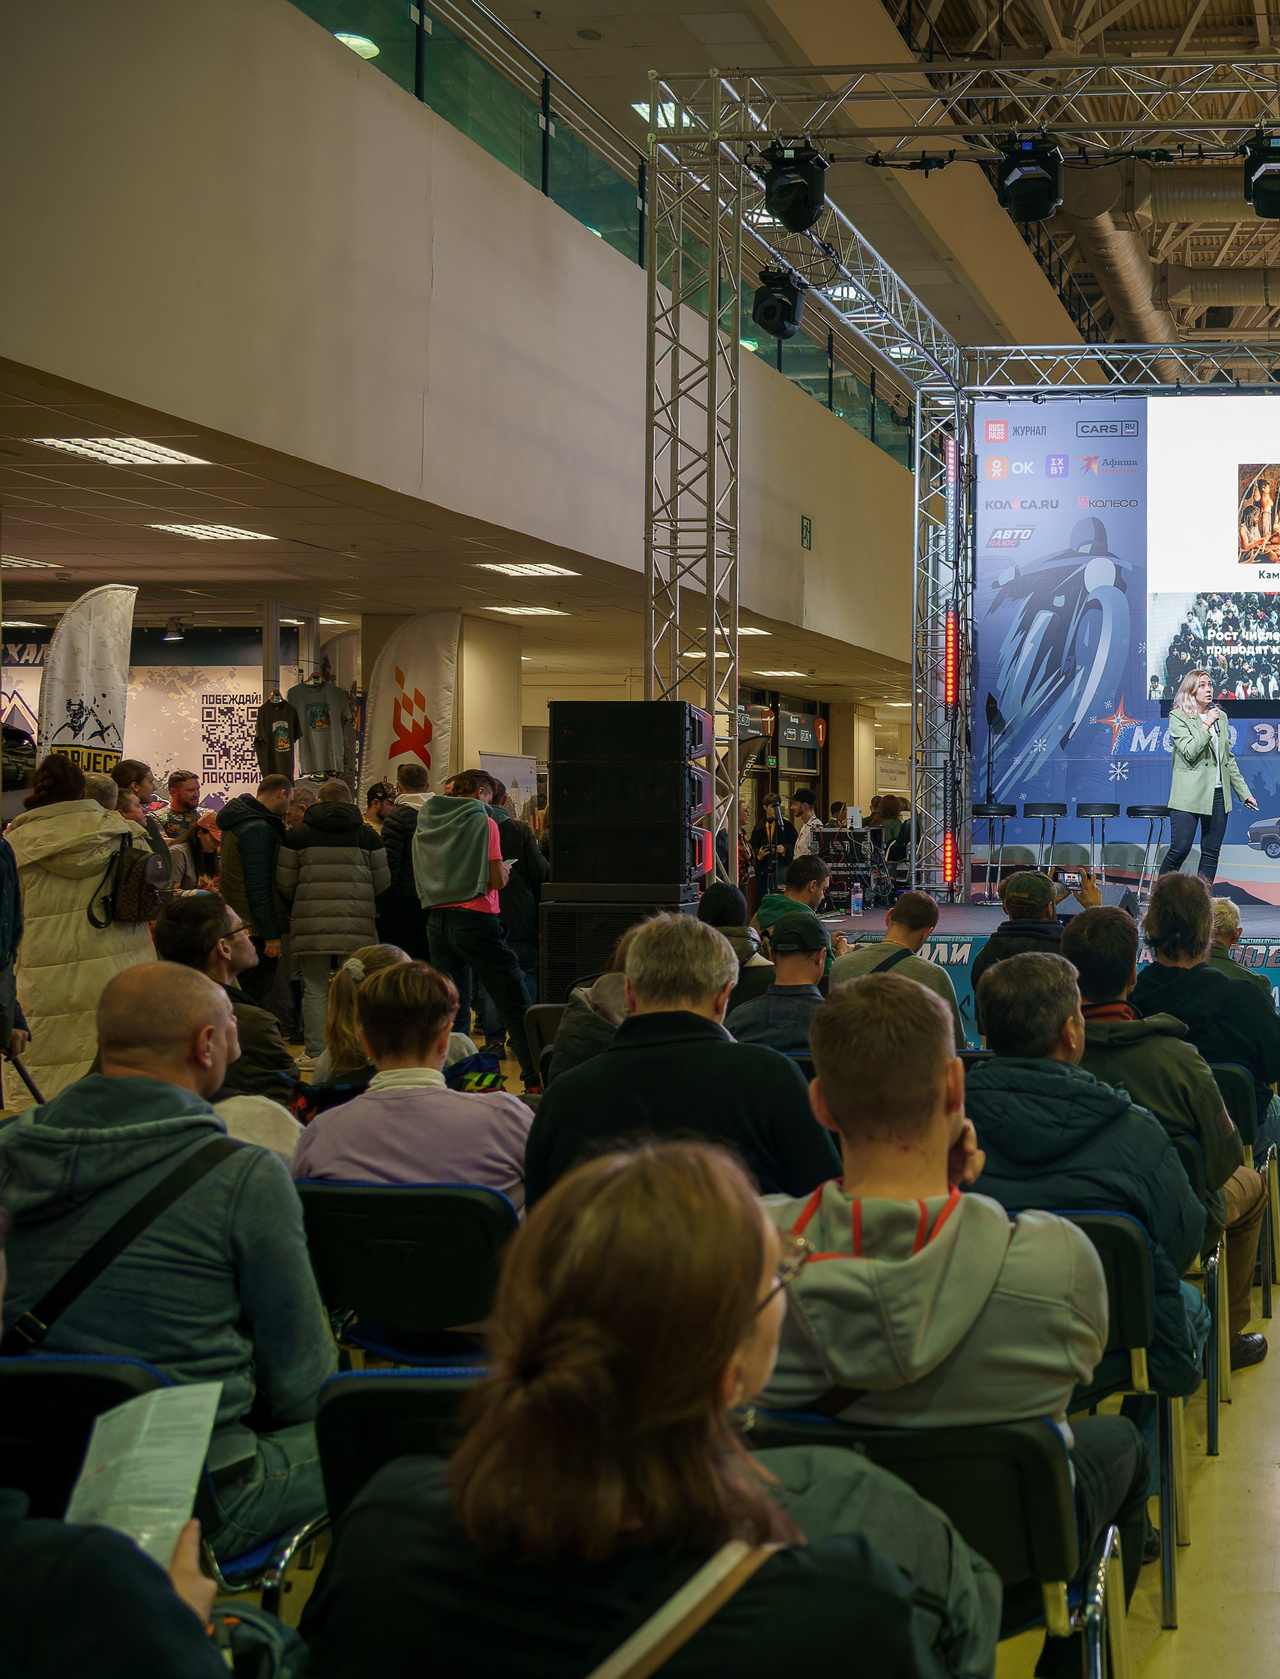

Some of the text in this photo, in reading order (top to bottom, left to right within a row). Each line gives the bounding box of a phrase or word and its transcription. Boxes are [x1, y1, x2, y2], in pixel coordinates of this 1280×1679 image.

[988, 423, 1005, 432] RUSS
[1012, 425, 1047, 437] ЖУРНАЛ
[1080, 424, 1118, 434] CARS
[988, 431, 1005, 440] PASS
[1101, 458, 1138, 468] Афиша
[1077, 496, 1139, 509] 5КОЛЕСО
[991, 529, 1032, 540] АВТО
[987, 539, 1018, 547] ПЛЮС
[1207, 629, 1239, 641] Рост
[1206, 645, 1269, 657] приводят
[1270, 645, 1280, 655] к
[201, 691, 262, 705] ПОБЕЖДАЙ!
